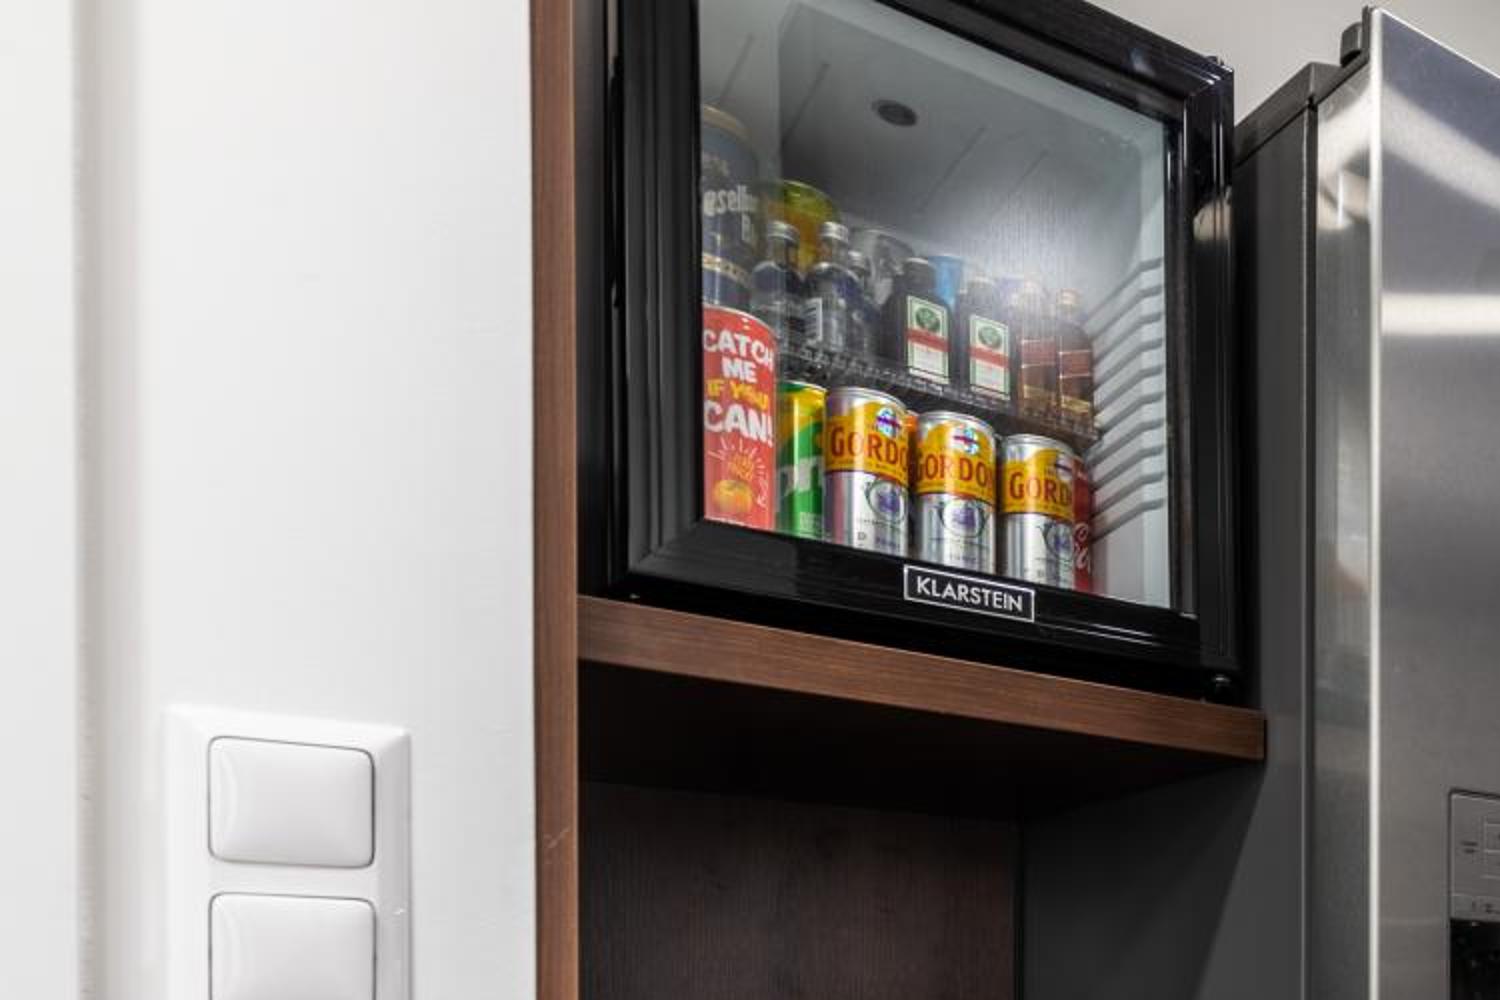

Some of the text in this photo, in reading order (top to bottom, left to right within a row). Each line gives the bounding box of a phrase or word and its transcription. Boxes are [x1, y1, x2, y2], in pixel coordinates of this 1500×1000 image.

[703, 328, 773, 373] CATCH
[722, 356, 758, 384] ME
[708, 380, 770, 412] IF YOU
[704, 400, 773, 447] CAN!
[917, 575, 1023, 612] KLARSTEIN
